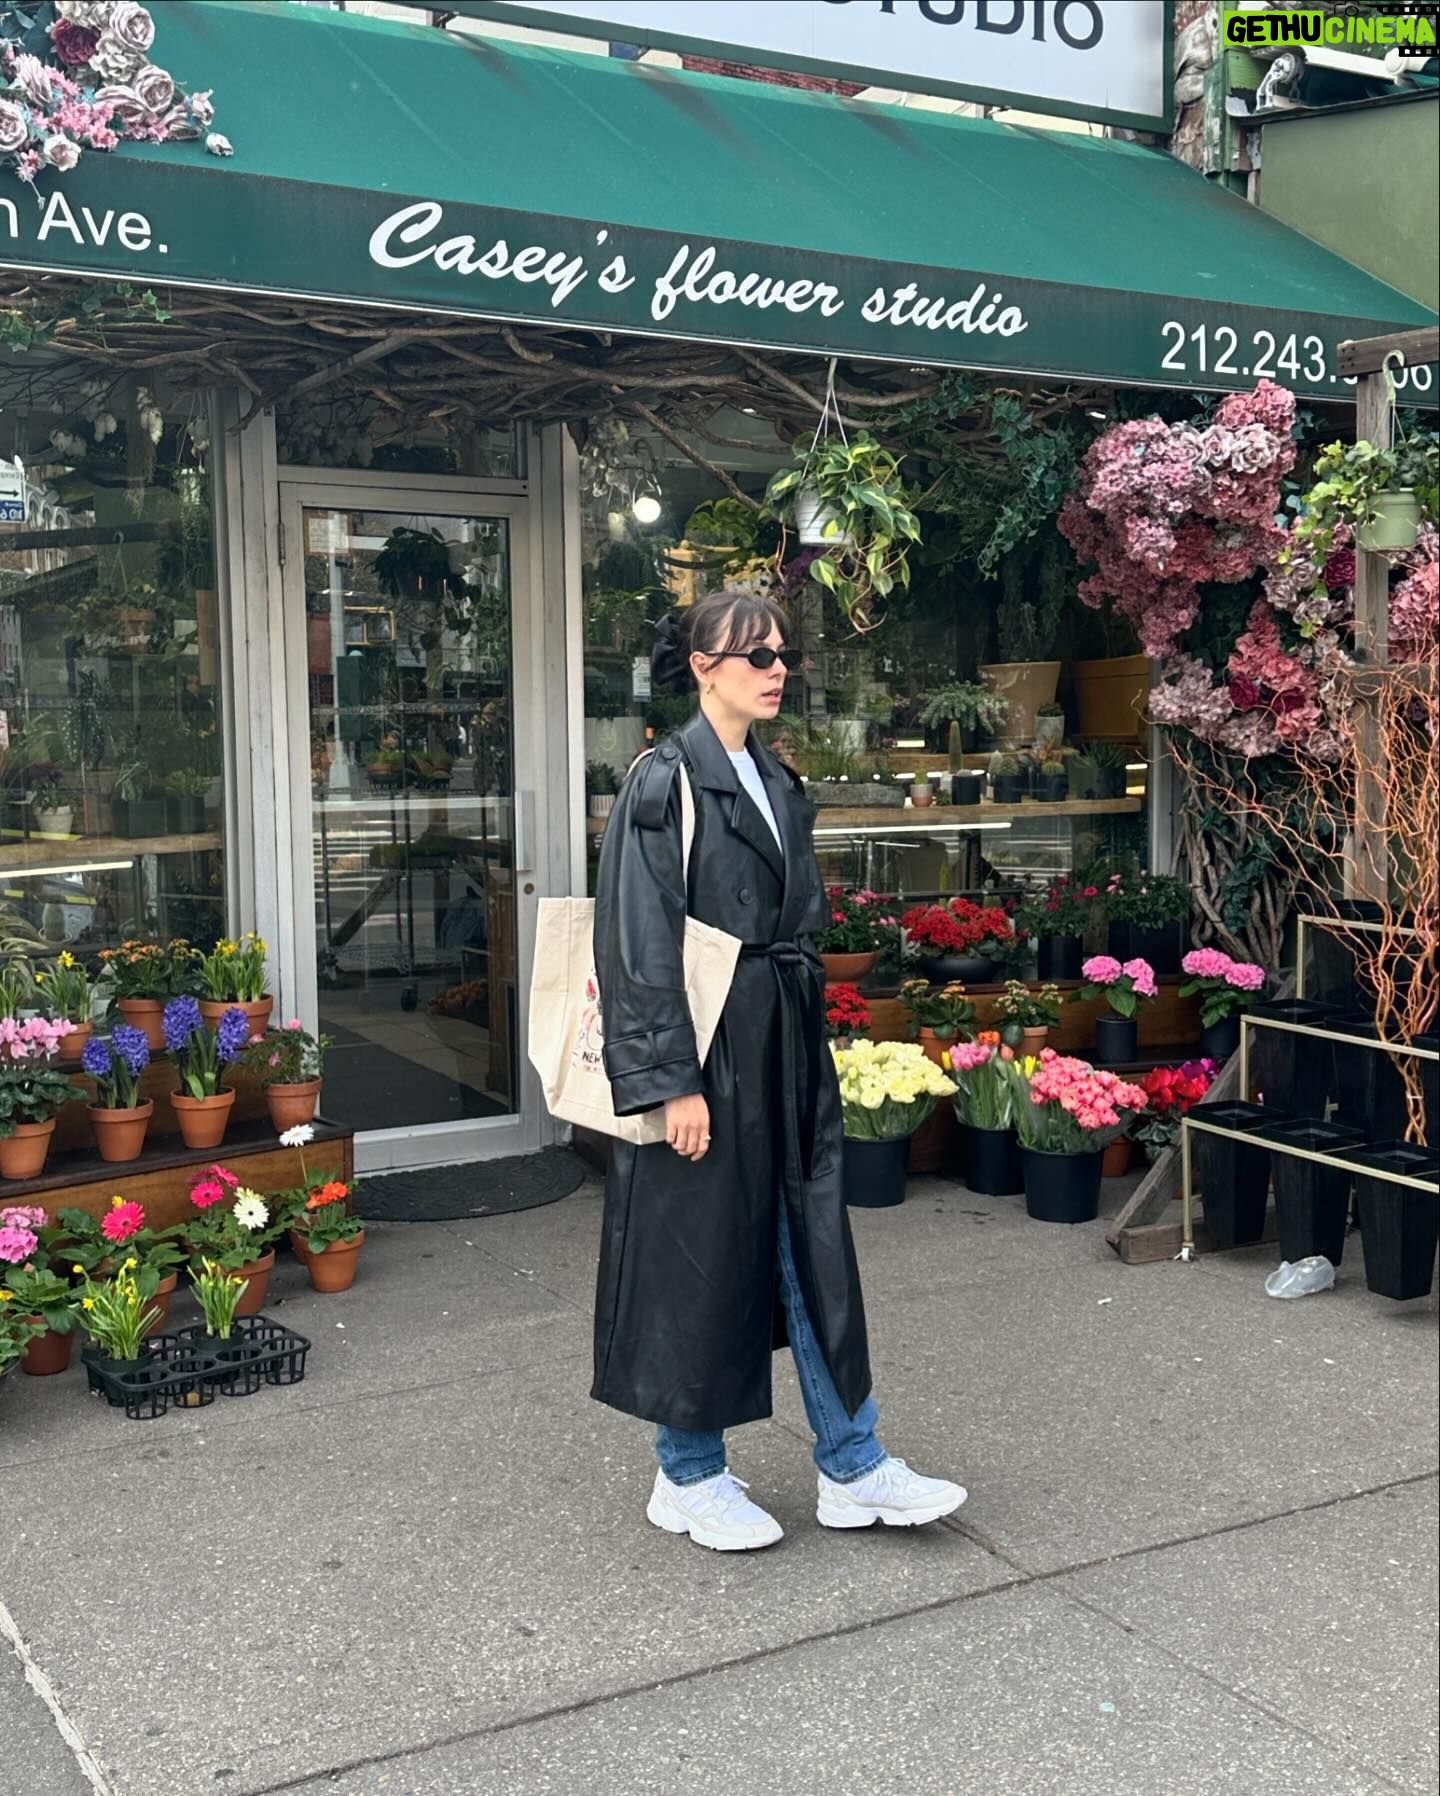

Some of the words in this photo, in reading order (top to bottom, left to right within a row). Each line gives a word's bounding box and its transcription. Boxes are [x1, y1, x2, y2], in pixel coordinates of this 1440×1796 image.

[822, 0, 1104, 50] DIO
[37, 191, 168, 253] Ave.
[369, 202, 635, 308] Casey's
[651, 244, 845, 321] flower
[861, 283, 1028, 337] studio
[1161, 321, 1432, 391] 212.243.6
